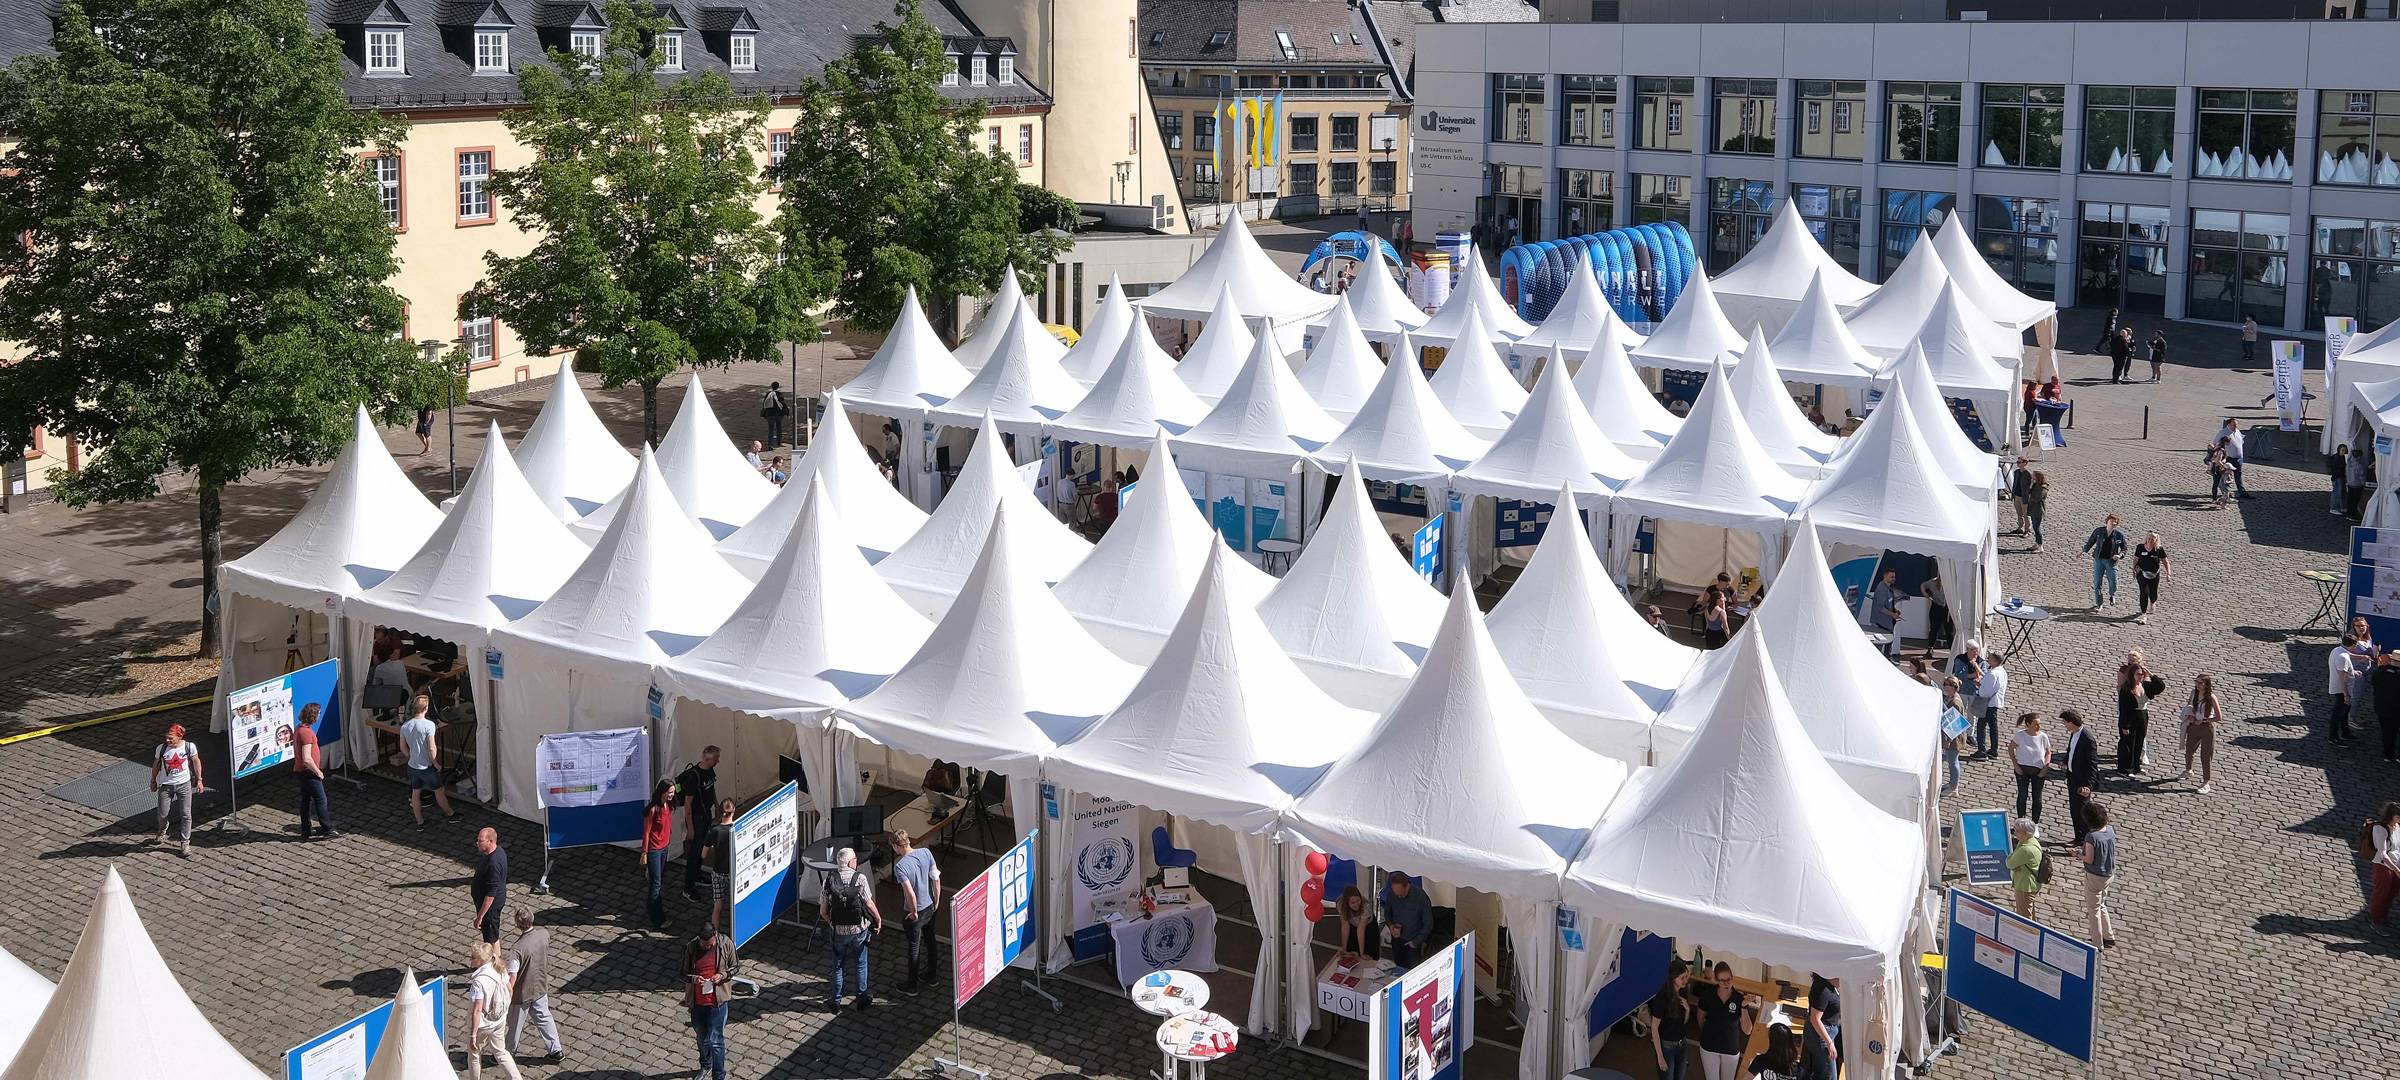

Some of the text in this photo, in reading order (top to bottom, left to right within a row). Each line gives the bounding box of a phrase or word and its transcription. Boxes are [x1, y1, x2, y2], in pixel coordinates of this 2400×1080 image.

[1438, 116, 1476, 124] Universität
[1438, 124, 1461, 135] Siegen
[1074, 807, 1102, 821] United
[1091, 818, 1120, 829] Siegen
